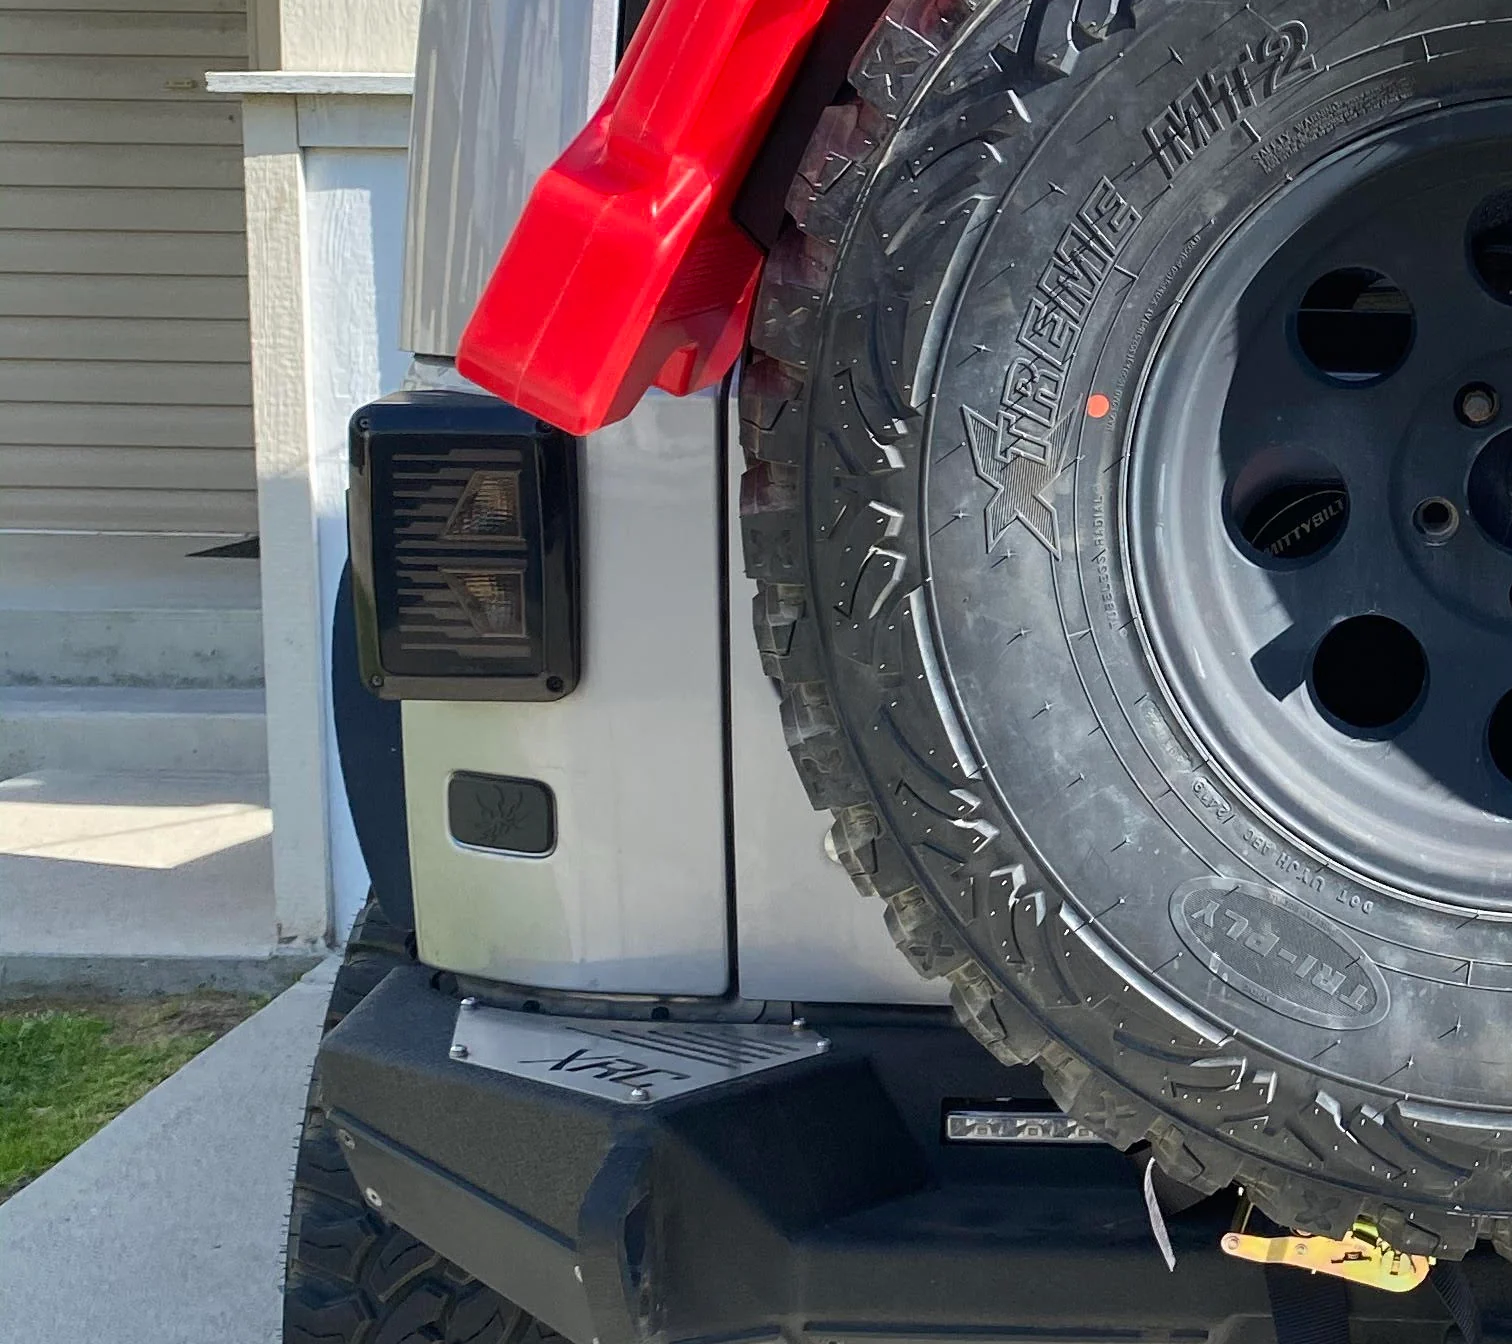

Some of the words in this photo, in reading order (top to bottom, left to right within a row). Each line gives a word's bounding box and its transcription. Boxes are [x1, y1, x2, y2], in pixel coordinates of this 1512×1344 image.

[961, 175, 1142, 561] XTREME
[1145, 19, 1317, 179] MT2
[1093, 495, 1105, 547] RADIAL
[1263, 496, 1345, 555] MITTYBILT
[1096, 555, 1118, 629] TUBELESS
[1338, 890, 1374, 914] DOT
[1191, 899, 1368, 1011] TRI-PLY
[518, 1048, 691, 1088] XRC
